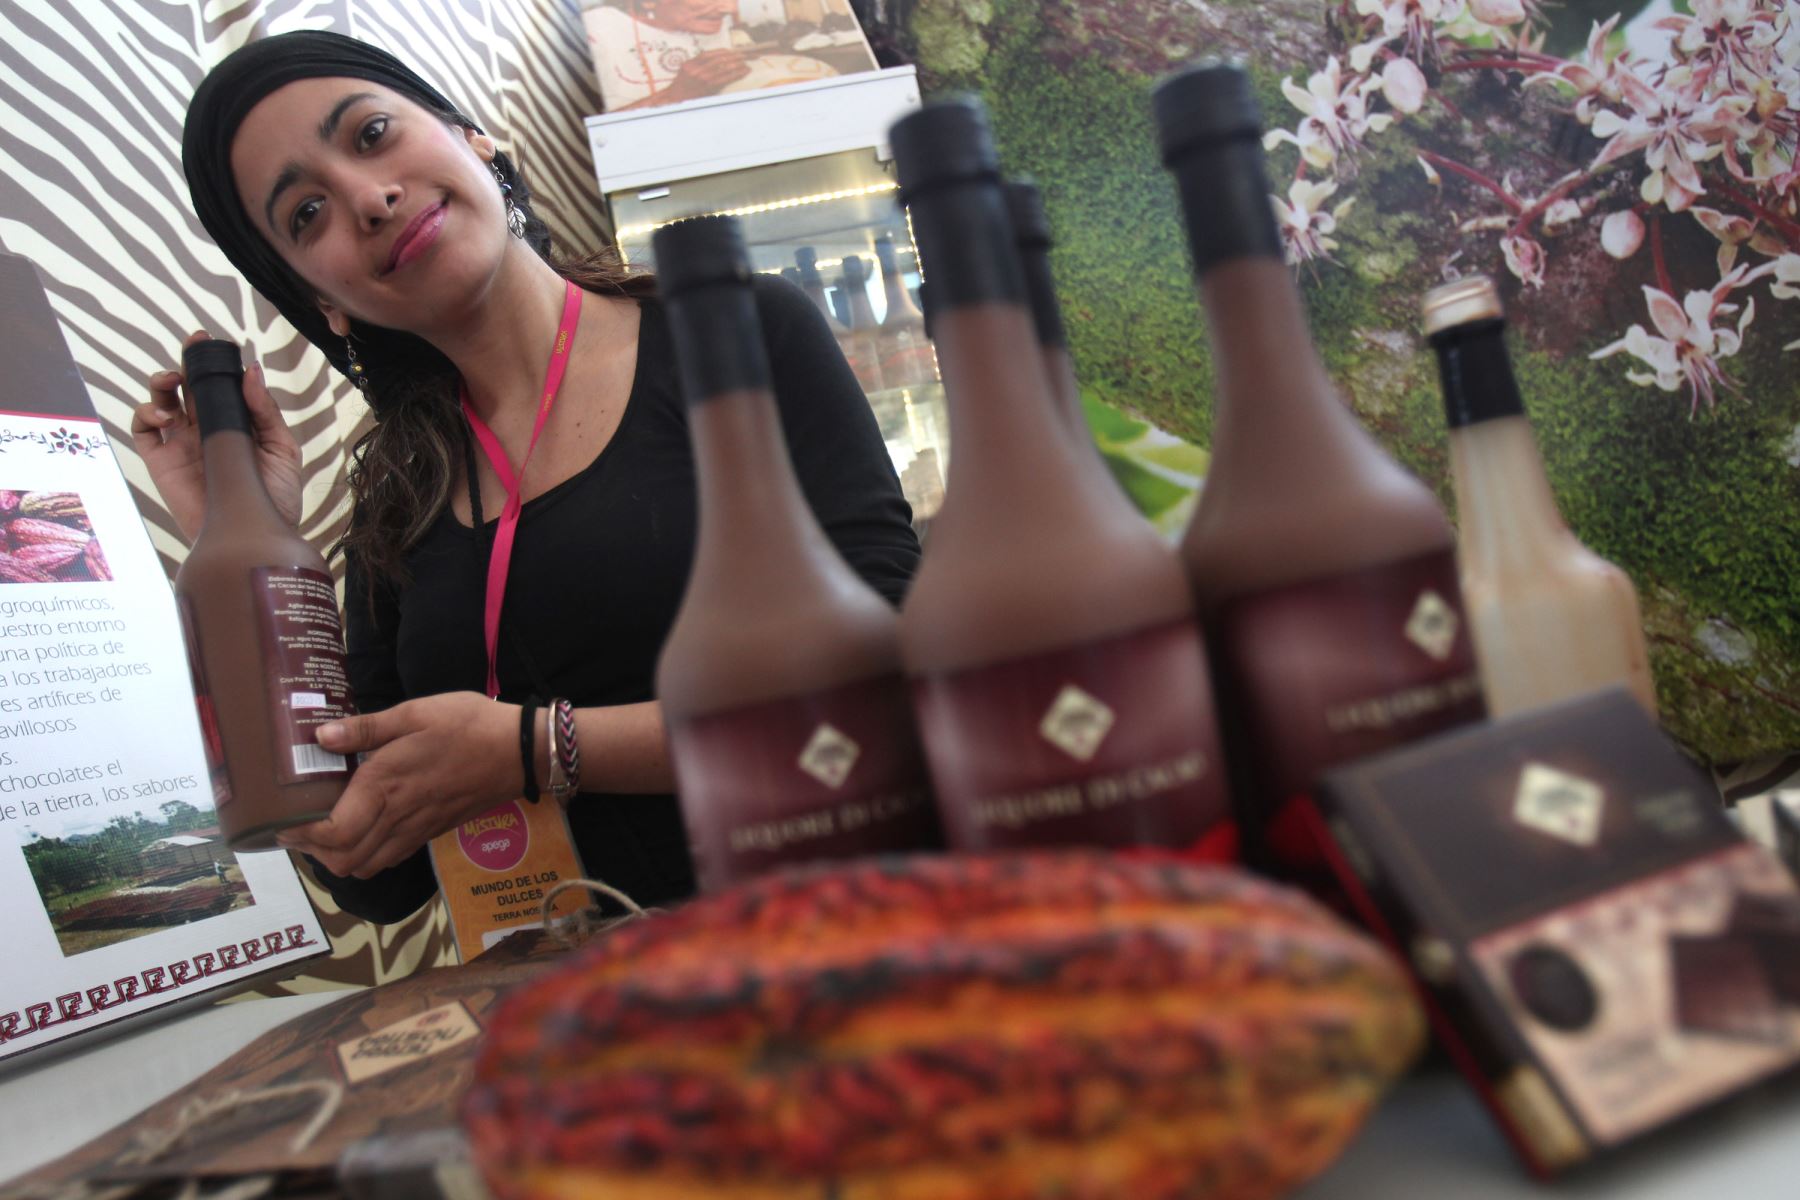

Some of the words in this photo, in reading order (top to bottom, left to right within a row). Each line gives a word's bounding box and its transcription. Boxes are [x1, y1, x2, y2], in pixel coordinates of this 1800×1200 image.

[57, 619, 126, 635] entorno
[34, 641, 99, 663] política
[103, 640, 125, 655] de
[12, 671, 40, 686] los
[44, 662, 152, 683] trabajadores
[28, 690, 96, 710] artífices
[100, 687, 123, 702] de
[0, 763, 103, 793] chocolates
[107, 760, 123, 775] el
[22, 800, 40, 816] la
[45, 793, 98, 812] tierra,
[102, 786, 129, 803] los
[133, 774, 198, 798] sabores
[481, 838, 511, 853] apega
[471, 879, 513, 897] MUNDO
[515, 876, 533, 888] DE
[535, 870, 559, 885] LOS
[497, 888, 544, 906] DULCES
[493, 910, 522, 922] TERRA
[523, 904, 559, 917] NOSA
